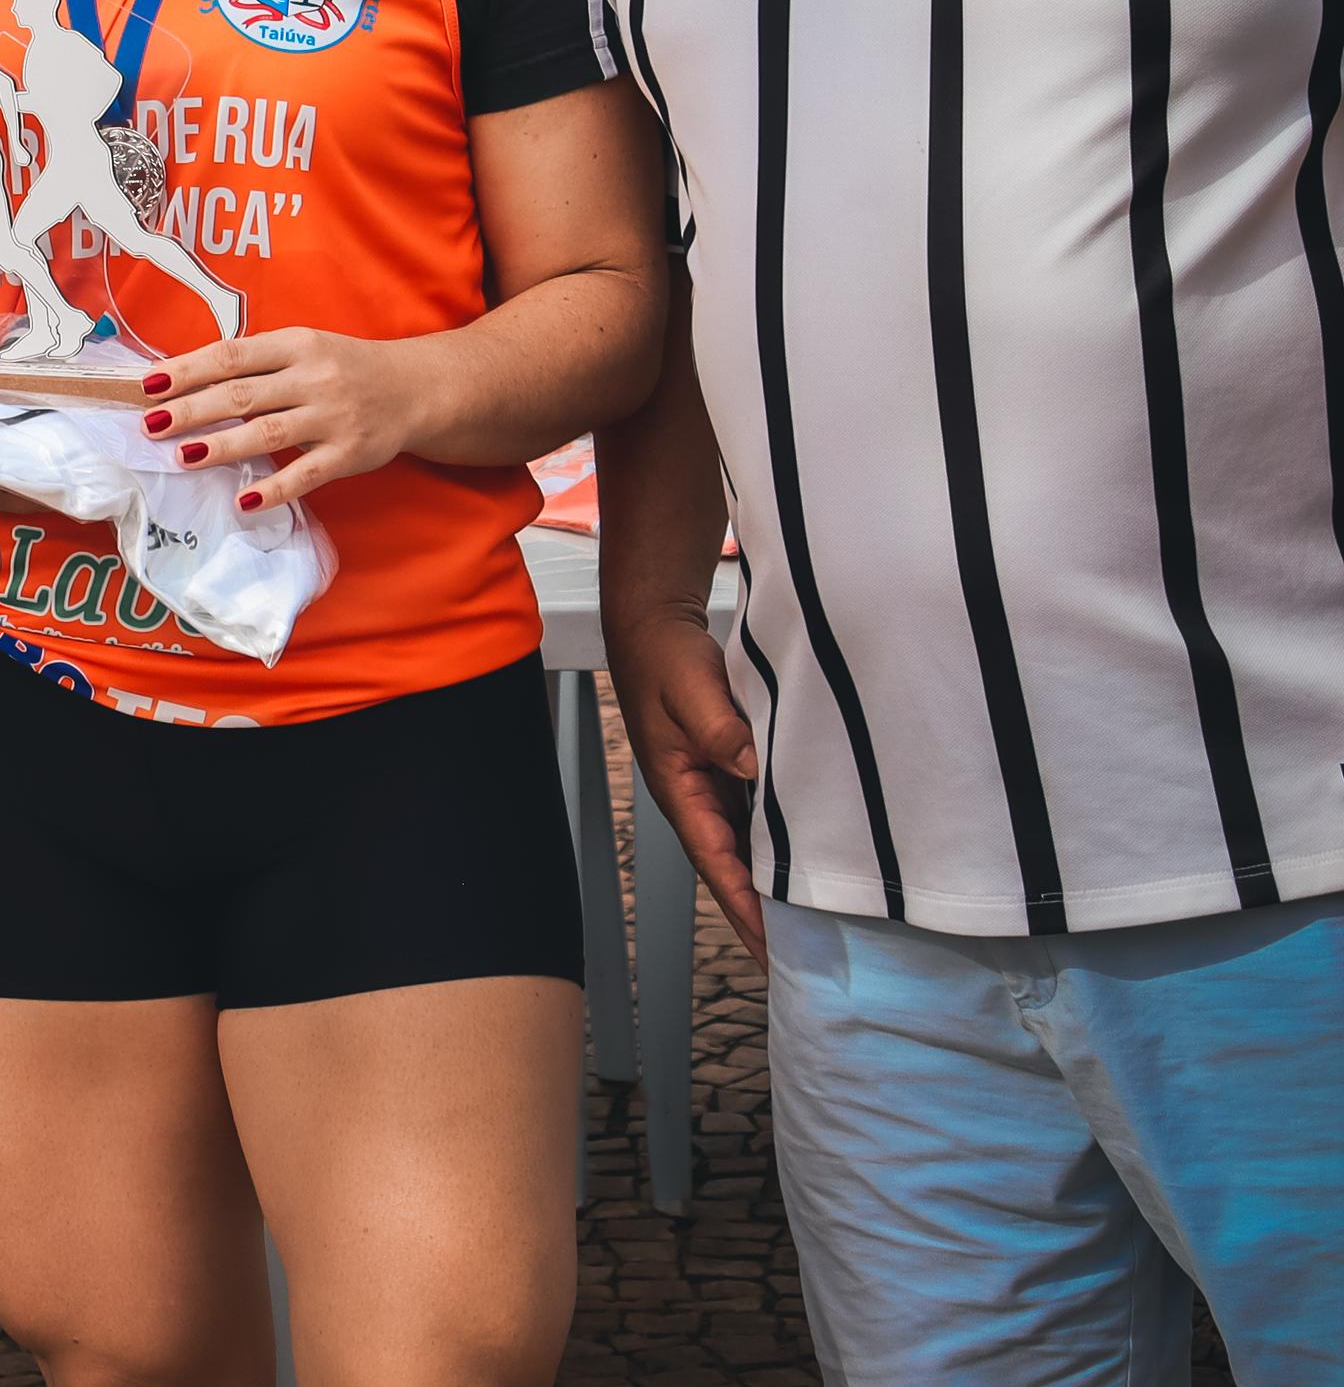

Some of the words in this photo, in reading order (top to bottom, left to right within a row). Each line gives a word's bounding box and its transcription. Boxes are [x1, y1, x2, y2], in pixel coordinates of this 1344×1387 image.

[259, 25, 316, 46] Taiúva
[137, 96, 204, 164] DE
[213, 98, 317, 172] RUA
